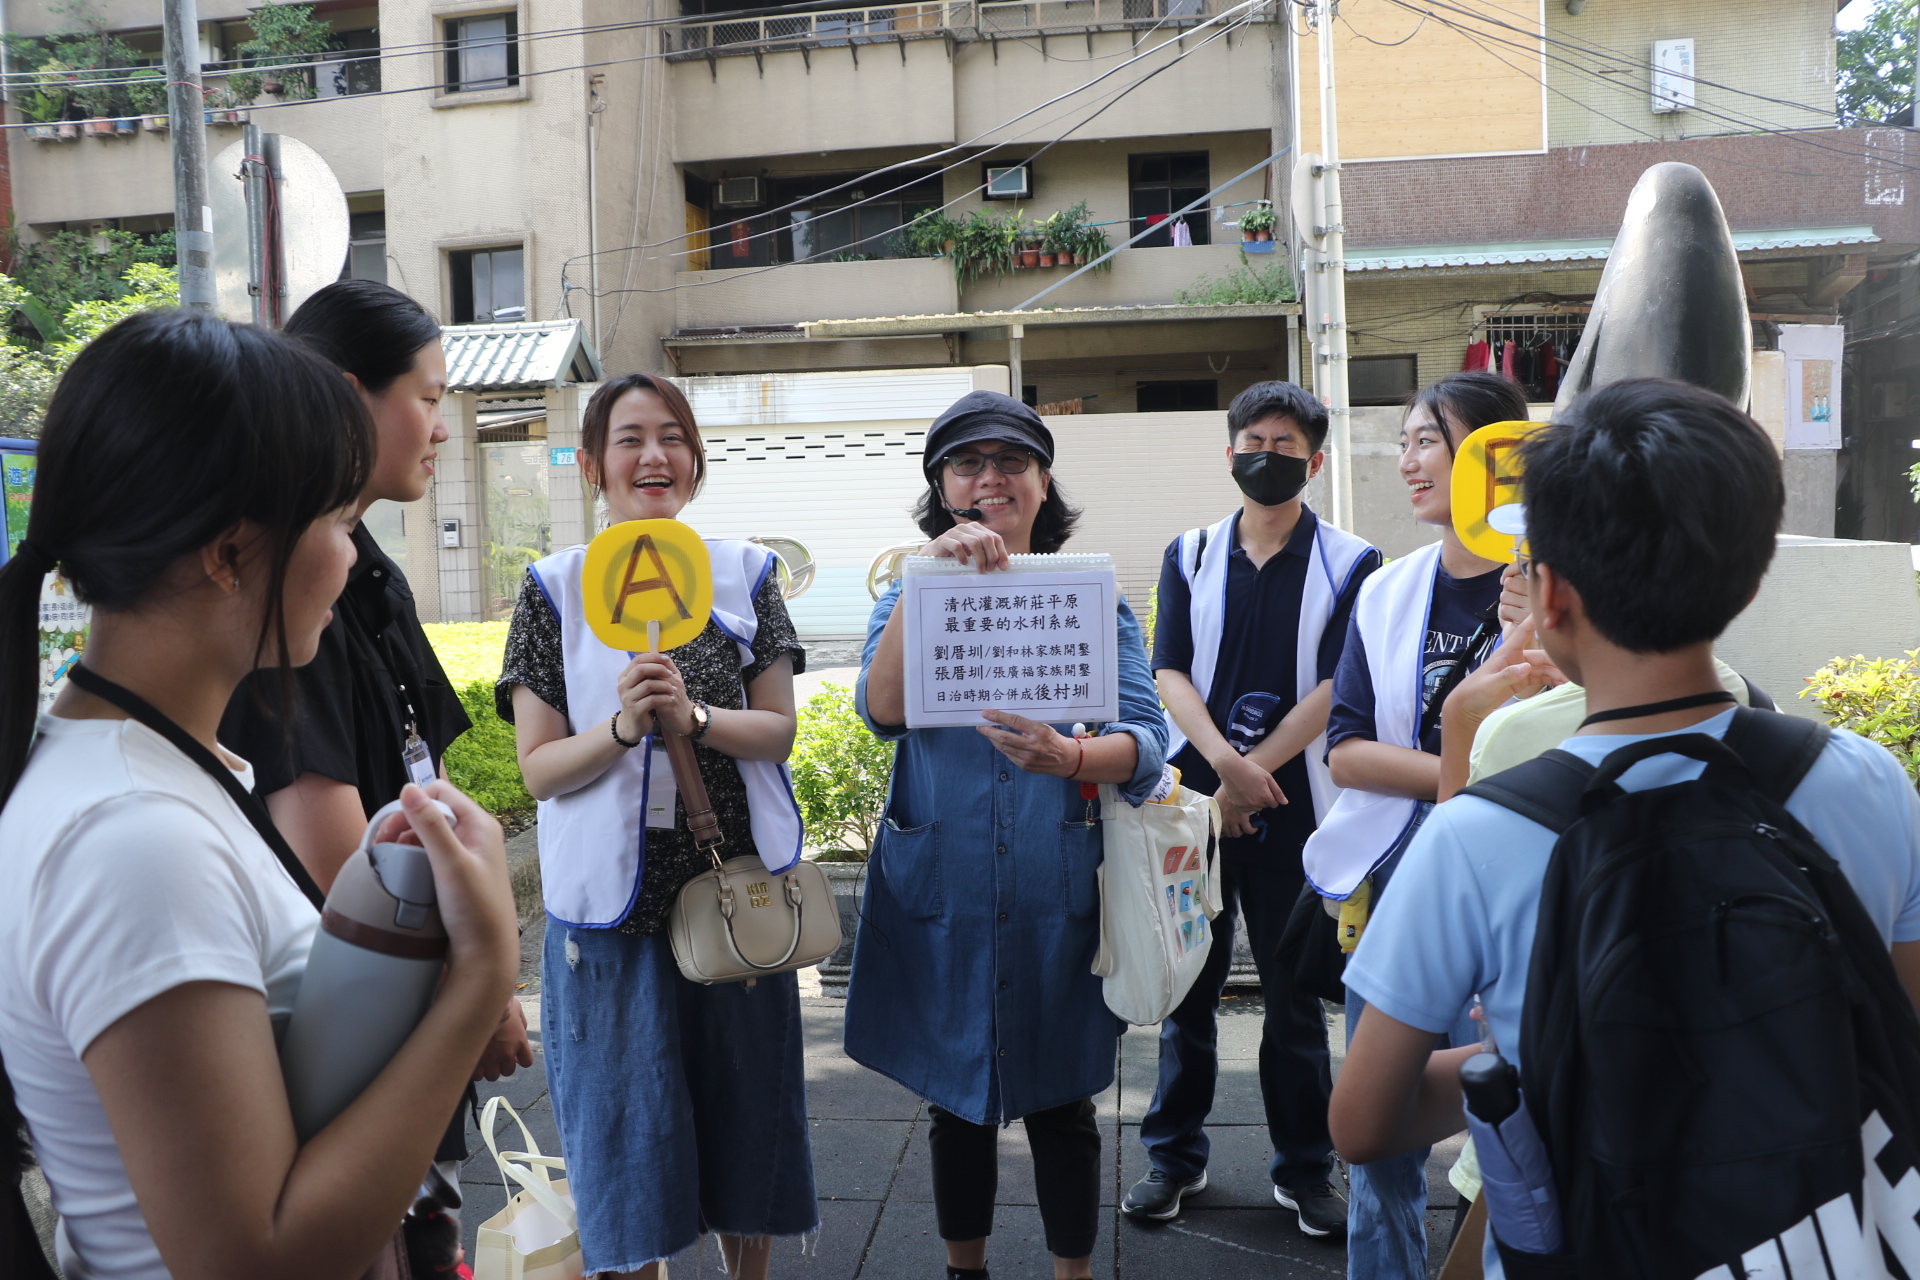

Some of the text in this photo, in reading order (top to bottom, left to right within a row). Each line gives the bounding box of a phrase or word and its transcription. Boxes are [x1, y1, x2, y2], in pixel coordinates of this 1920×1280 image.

[561, 453, 572, 463] 76
[611, 533, 693, 624] A
[944, 594, 1078, 612] 清代灌溉新莊平原
[944, 614, 1080, 633] 最重要的水利系統
[937, 683, 1089, 702] 日治時期合併成後村圳
[1694, 1109, 1920, 1280] KE
